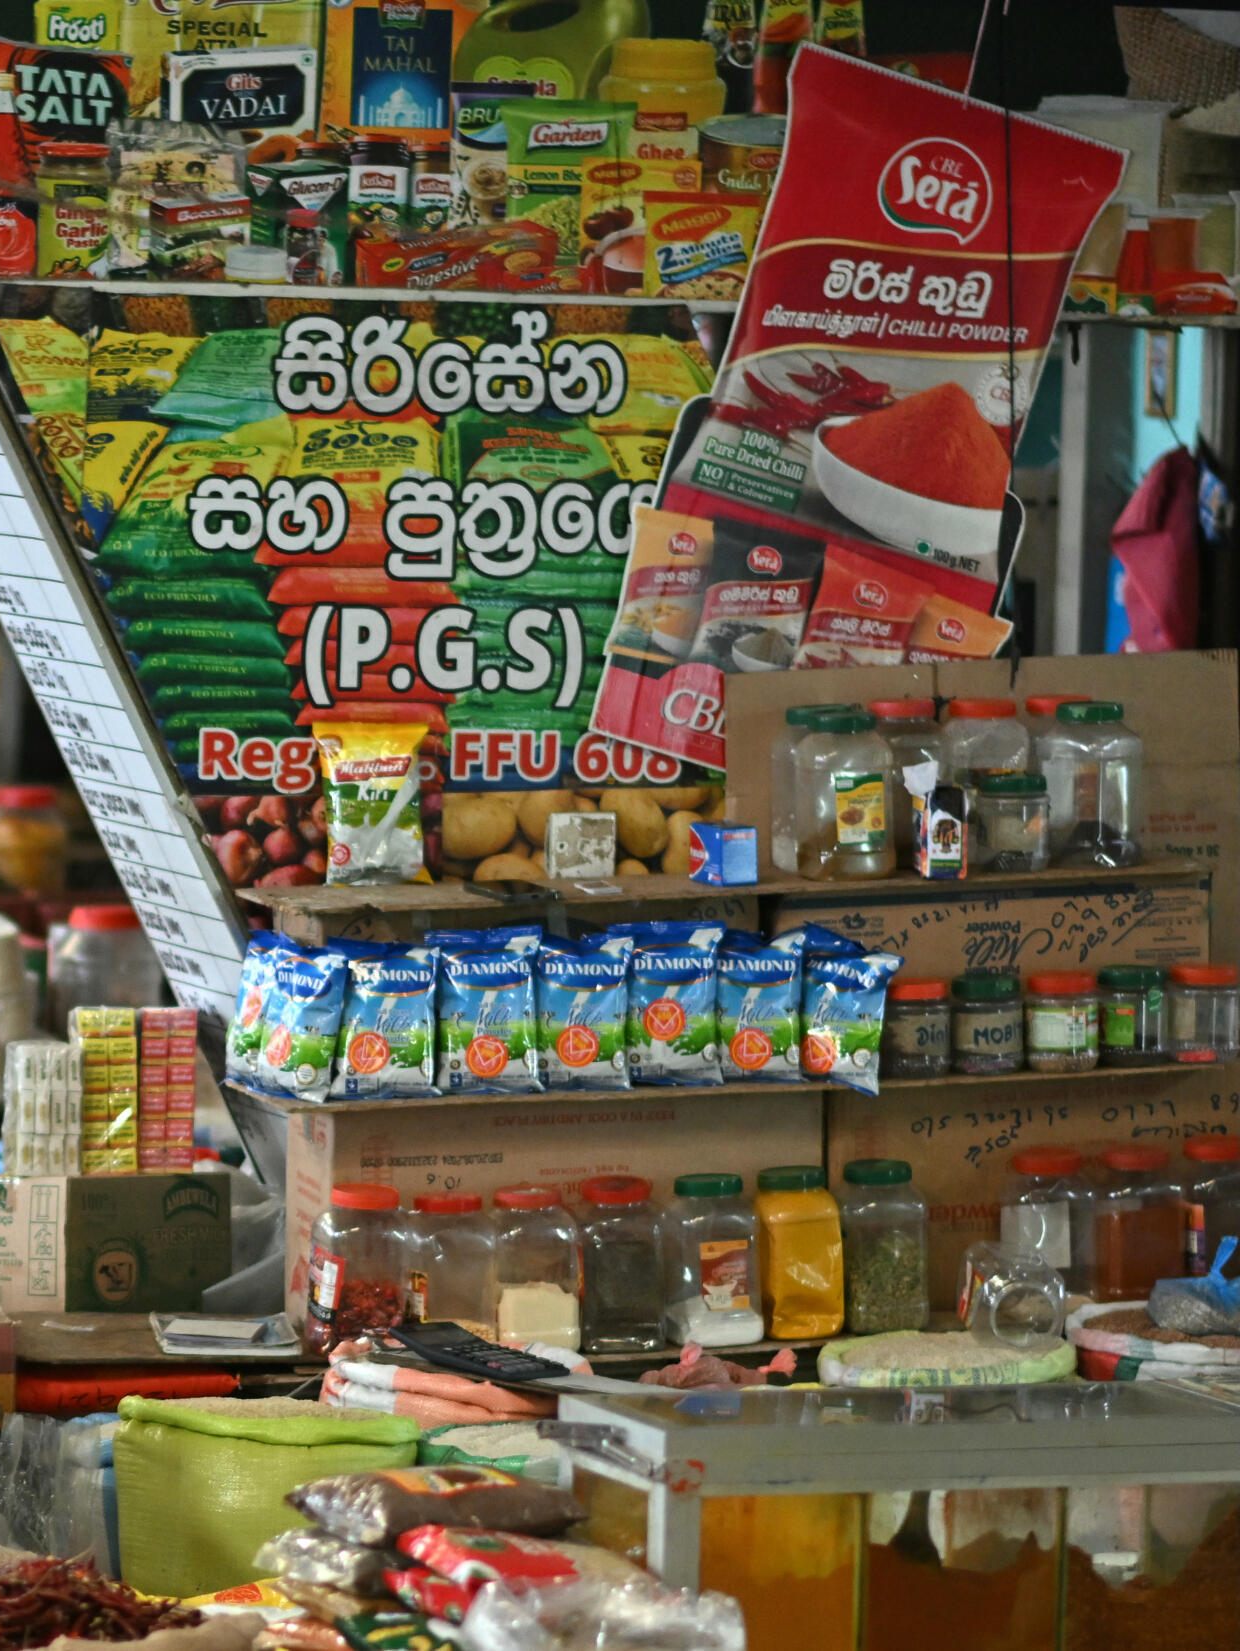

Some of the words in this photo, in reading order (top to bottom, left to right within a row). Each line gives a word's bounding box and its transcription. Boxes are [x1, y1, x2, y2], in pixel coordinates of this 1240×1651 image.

[48, 15, 106, 43] Frooti
[167, 20, 267, 37] SPECIAL
[384, 35, 415, 55] TAJ
[363, 56, 438, 73] MAHAL
[15, 64, 112, 97] TATA
[14, 94, 112, 126] SALT
[200, 95, 287, 119] VADAI
[459, 107, 500, 124] BRU
[533, 124, 603, 143] Garden
[637, 143, 685, 160] Ghee
[523, 168, 559, 180] Lemon
[287, 176, 343, 197] Glucon-D
[56, 222, 107, 239] Garlic
[67, 237, 100, 248] Paste
[406, 254, 480, 288] Digestive
[823, 257, 915, 304] මිරිස්
[917, 270, 993, 319] කුඩු
[888, 320, 943, 338] CHILLI
[947, 325, 1028, 344] POWDER
[274, 310, 626, 414] සිරිසේන
[741, 430, 781, 455] 100%
[705, 437, 736, 460] Pure
[736, 446, 770, 471] Dried
[772, 458, 805, 482] Chilli
[699, 462, 723, 481] NO
[190, 478, 349, 554] සහ
[185, 629, 236, 639] FRIENDLY
[303, 603, 584, 709] (P.G.S)
[198, 729, 316, 794] Reg
[451, 730, 561, 782] FFU
[965, 921, 1021, 935] Powder
[449, 960, 532, 977] DIAMOND
[544, 961, 626, 977] DIAMOND
[634, 957, 714, 971] DIAMOND
[717, 957, 797, 972] DIAMOND
[476, 1026, 512, 1038] Powder
